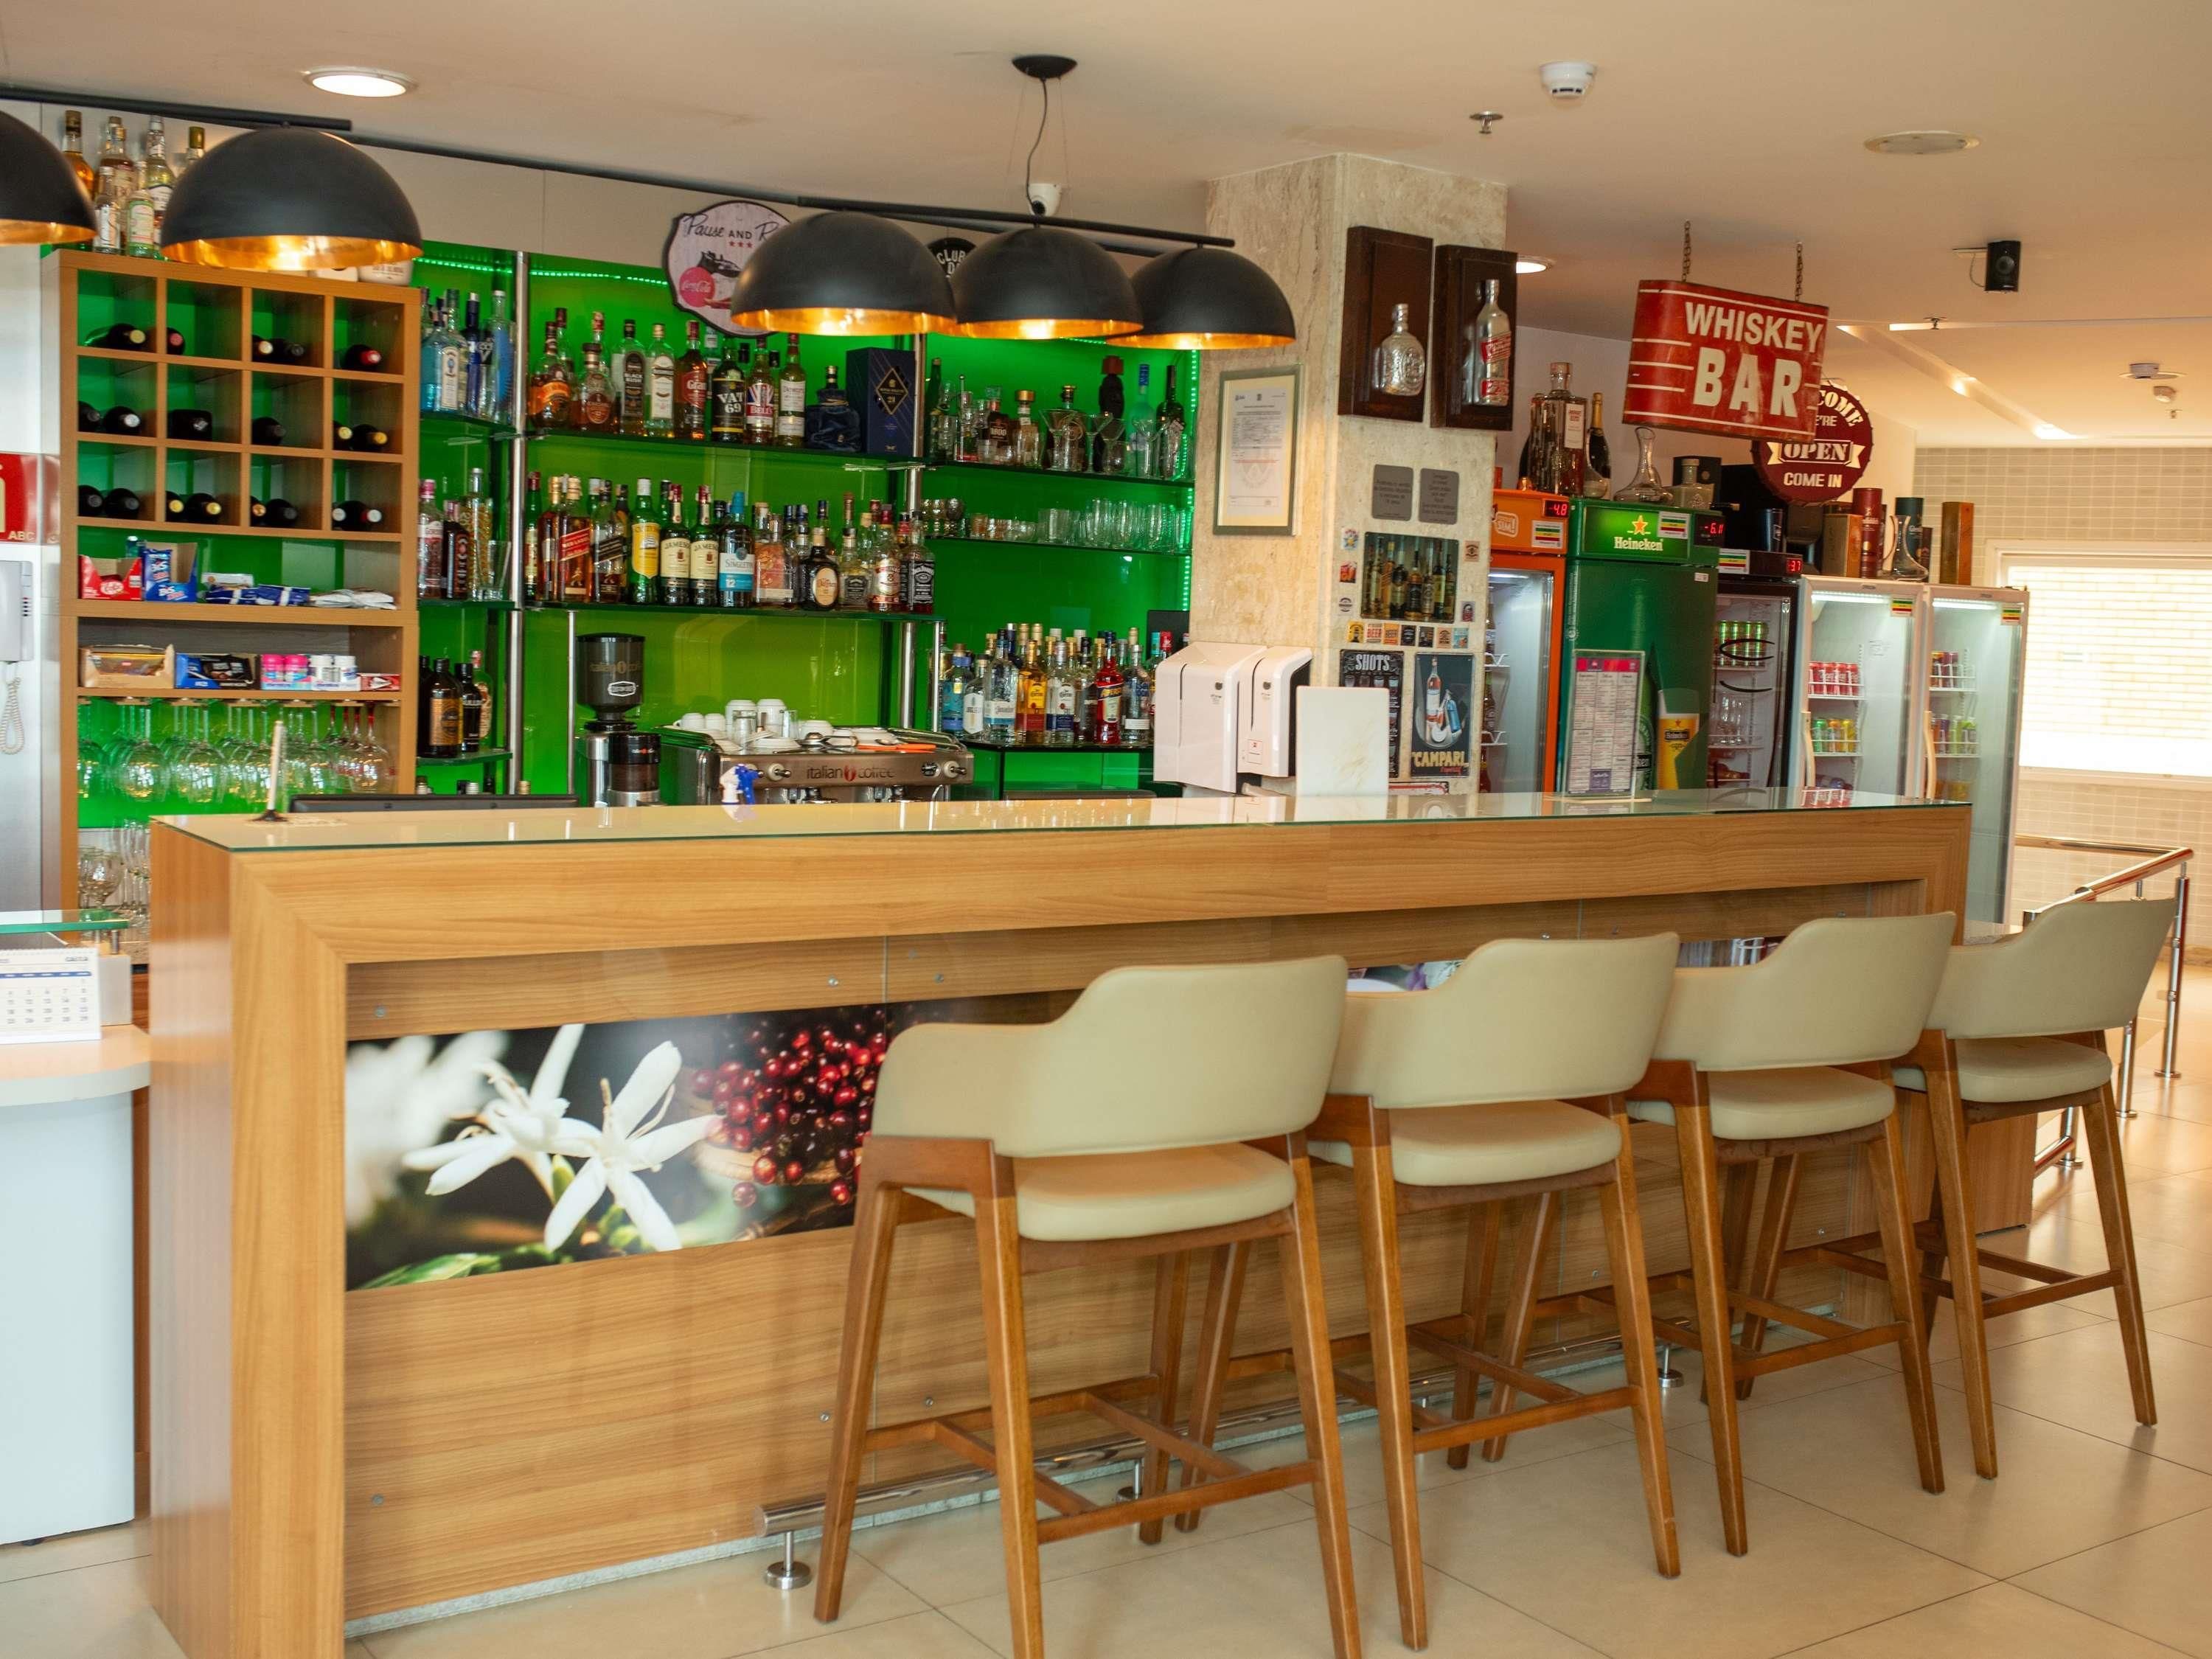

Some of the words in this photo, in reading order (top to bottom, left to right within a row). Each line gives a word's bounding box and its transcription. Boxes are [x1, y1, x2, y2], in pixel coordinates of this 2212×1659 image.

[683, 214, 725, 237] Pause
[728, 230, 753, 240] AND
[1685, 301, 1824, 353] WHISKEY
[1693, 347, 1803, 418] BAR
[717, 392, 744, 403] VAT
[724, 403, 742, 414] 69
[1783, 442, 1849, 462] OPEN
[1783, 471, 1825, 487] COME
[1827, 474, 1843, 488] IN
[8, 531, 35, 540] ABC
[1613, 536, 1663, 551] Heineken
[1355, 653, 1391, 672] SHOTS
[807, 765, 843, 779] italian
